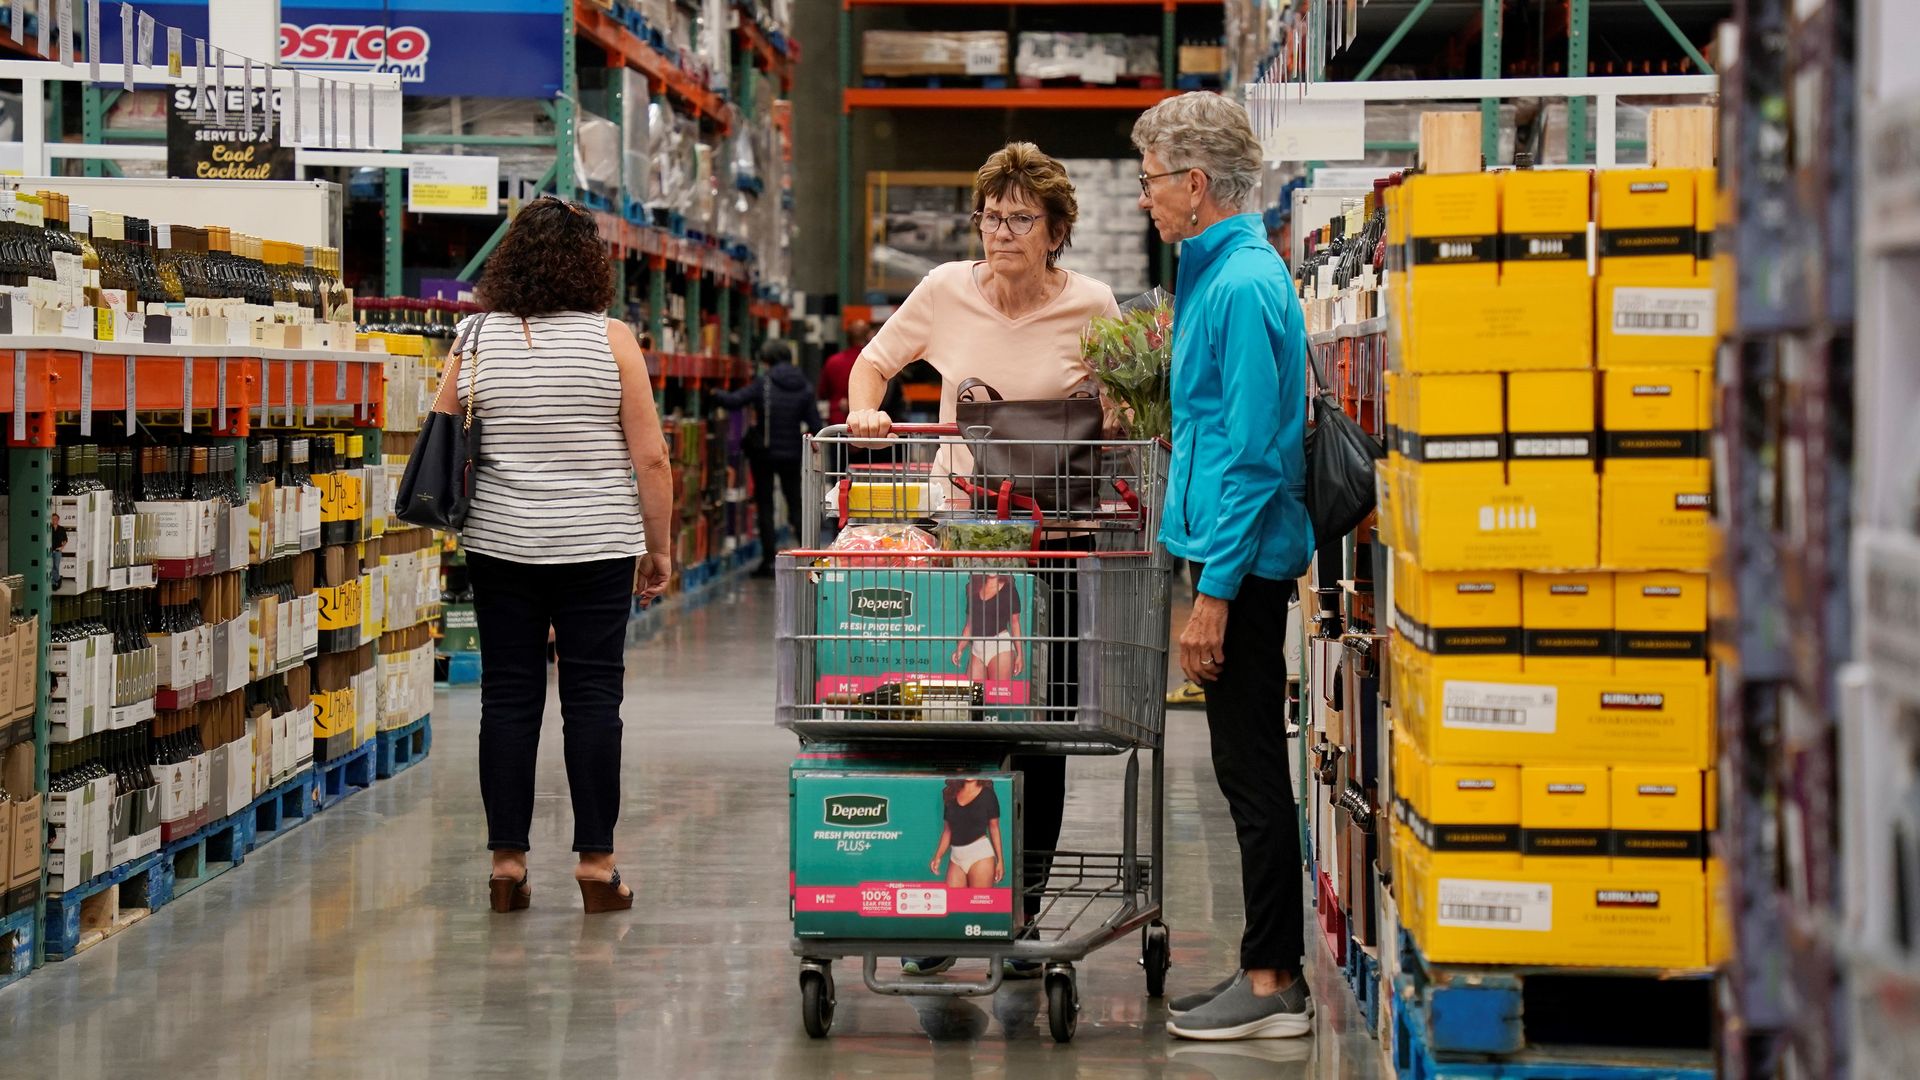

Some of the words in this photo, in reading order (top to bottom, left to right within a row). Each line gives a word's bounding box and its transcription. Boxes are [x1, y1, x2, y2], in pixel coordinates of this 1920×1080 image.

[280, 25, 427, 61] OSTCO
[174, 89, 245, 110] SAVE
[195, 130, 235, 141] SERVE
[239, 130, 257, 141] UP
[259, 132, 269, 142] A
[212, 144, 255, 162] Cool
[196, 160, 271, 179] Cocktail
[1677, 494, 1711, 505] KIRK
[839, 683, 849, 692] M
[1602, 693, 1663, 705] KIRKLAND
[832, 804, 882, 819] Depend
[814, 831, 841, 840] FRESH
[843, 831, 898, 840] PROTECTION
[836, 841, 871, 851] PLUS+
[815, 894, 825, 904] M
[861, 890, 892, 900] 100%
[1598, 891, 1659, 903] KIRKLAND
[965, 925, 981, 936] 88
